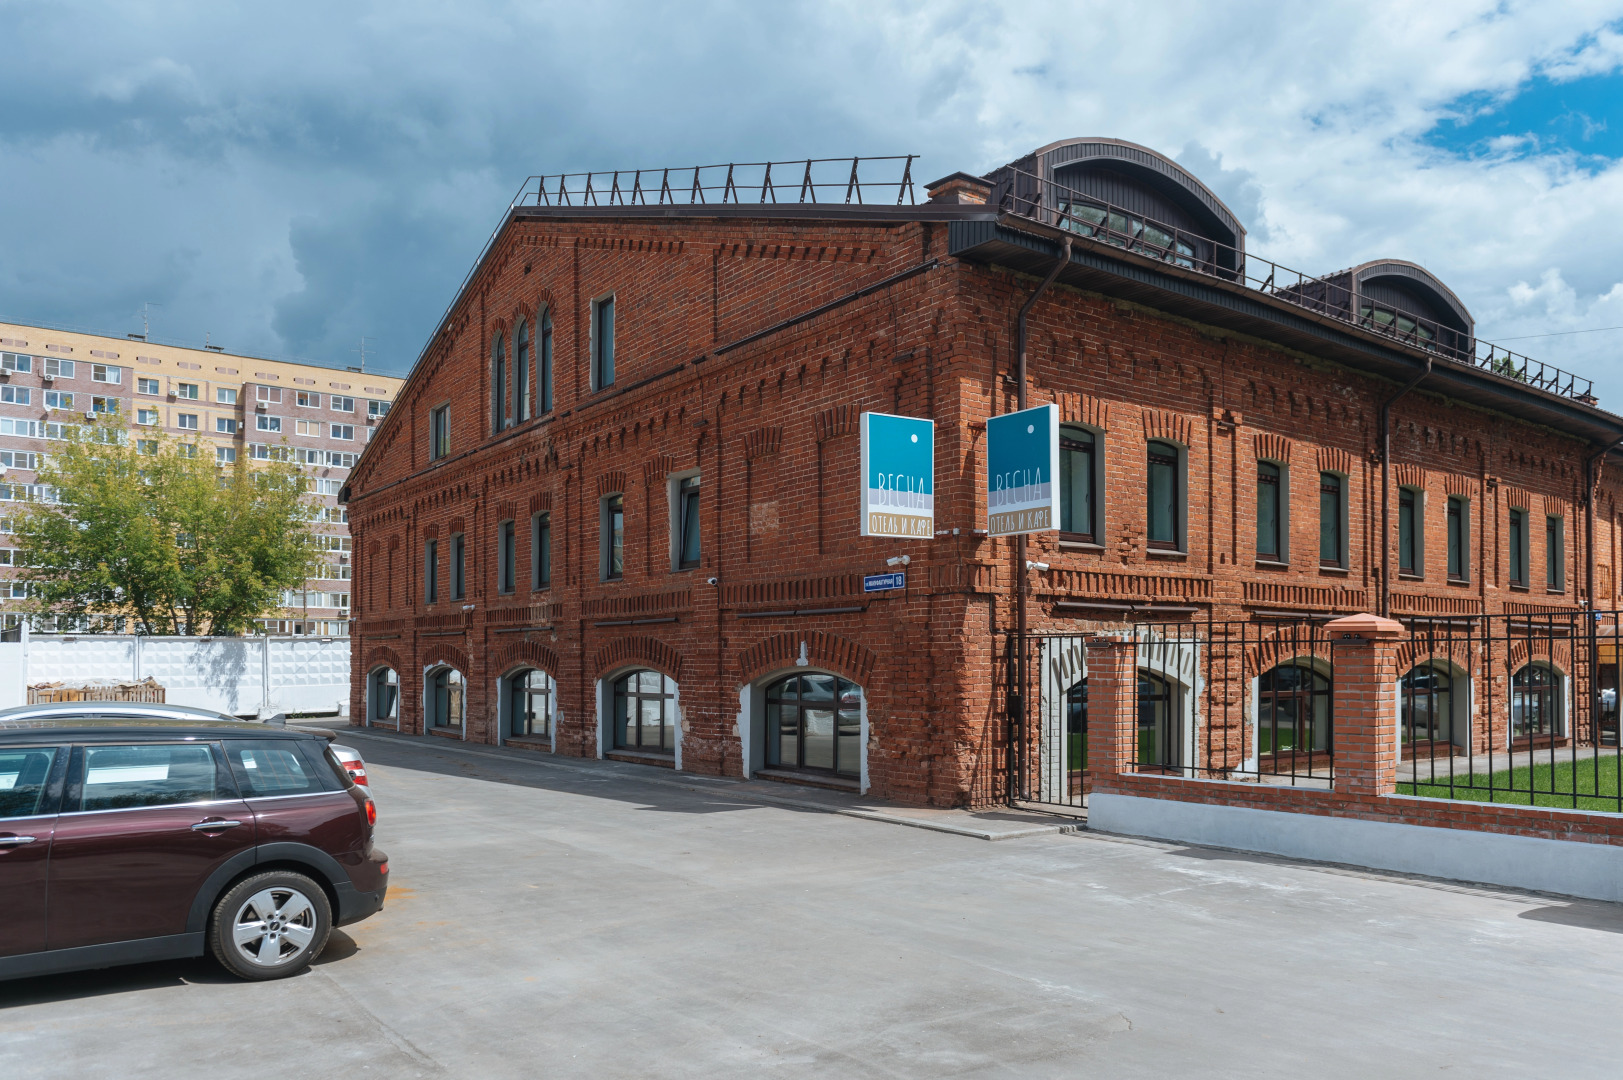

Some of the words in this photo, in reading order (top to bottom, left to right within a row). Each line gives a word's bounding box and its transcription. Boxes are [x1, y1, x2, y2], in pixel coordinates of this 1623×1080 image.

[879, 472, 925, 509] ВЕСНА
[997, 467, 1042, 506] ВЕСНА
[872, 515, 898, 533] ОТЕЛЬ
[901, 517, 907, 534] И
[911, 518, 931, 536] КАФЕ
[990, 514, 1015, 533] ОТЕЛЬ
[1018, 512, 1024, 530] И
[1027, 509, 1049, 529] КАФЕ
